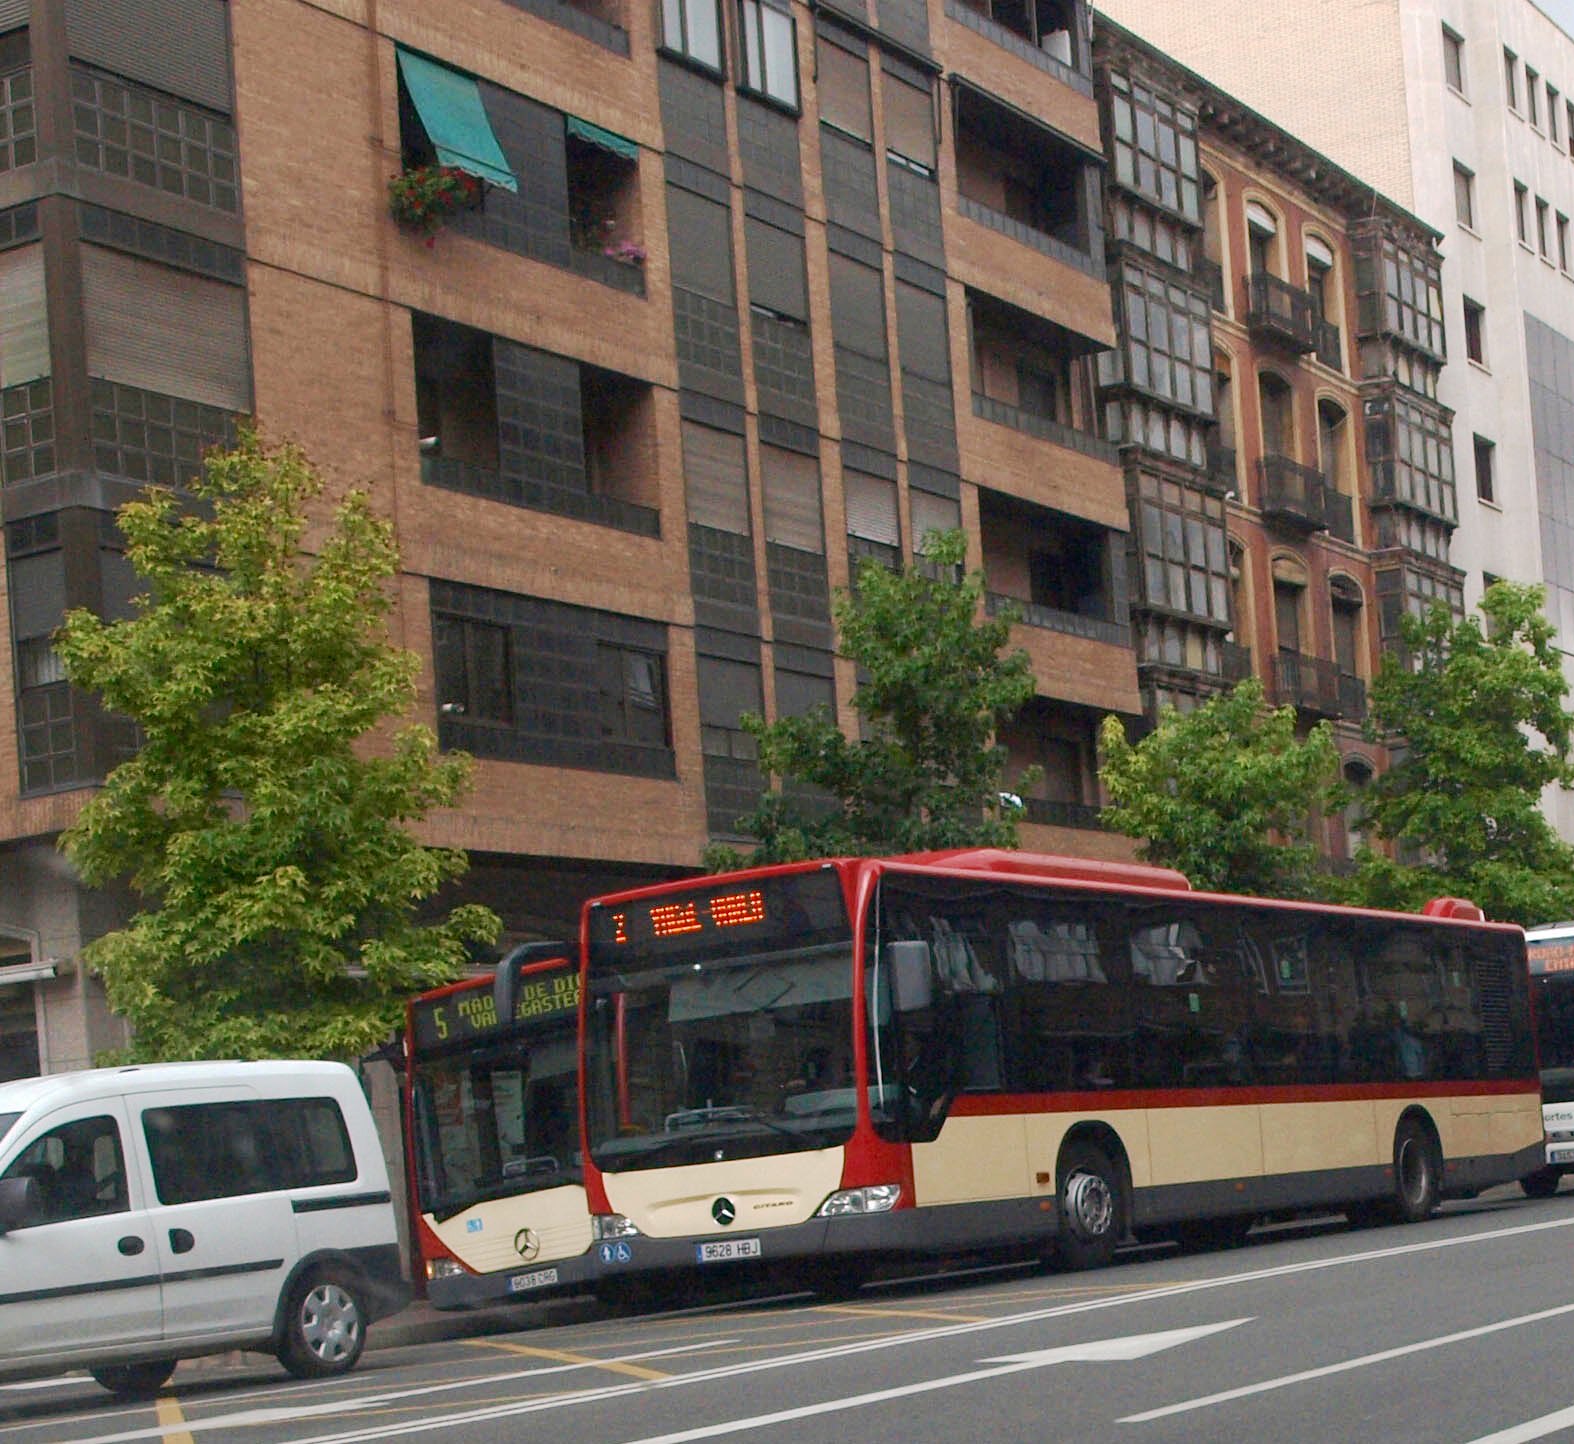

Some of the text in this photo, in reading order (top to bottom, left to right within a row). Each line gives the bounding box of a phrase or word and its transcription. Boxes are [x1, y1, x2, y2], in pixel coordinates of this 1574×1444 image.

[433, 1007, 448, 1039] 5
[524, 982, 549, 1000] DE
[704, 1242, 732, 1259] 9628
